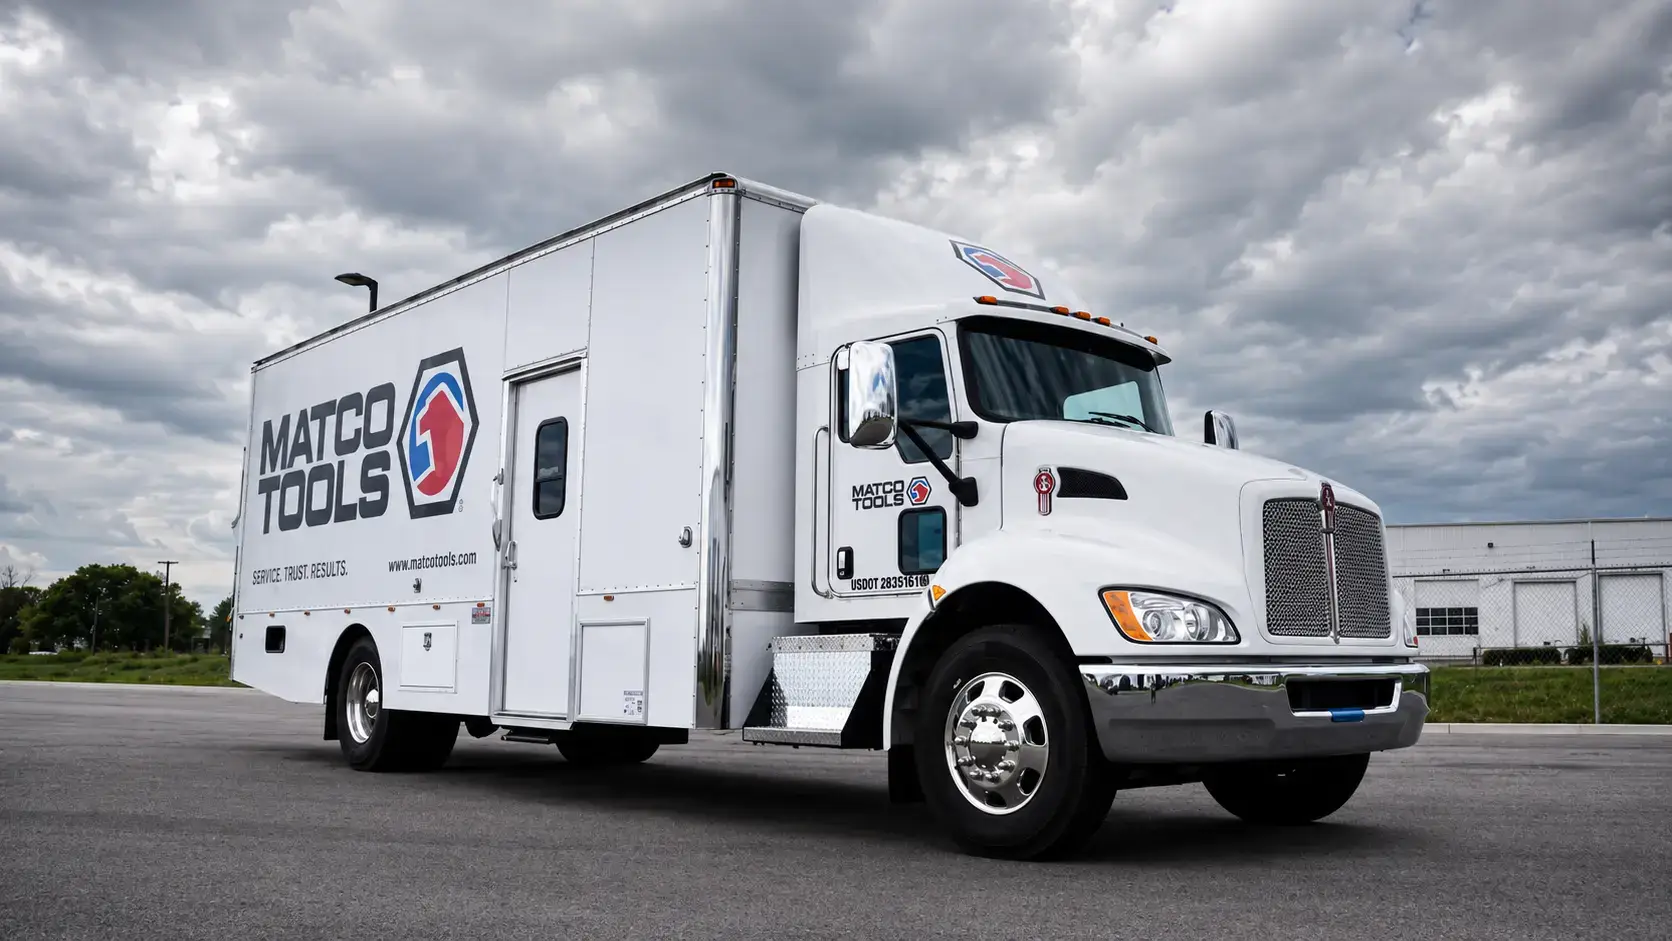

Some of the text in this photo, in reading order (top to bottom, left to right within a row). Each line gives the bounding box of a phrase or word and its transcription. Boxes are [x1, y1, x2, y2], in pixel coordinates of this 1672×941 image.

[259, 381, 396, 476] MATCO
[257, 449, 391, 535] TOOLS
[851, 480, 905, 498] MATCO
[851, 493, 905, 511] TOOLS
[252, 559, 348, 586] SERVICE. TRUST. RESULTS.
[388, 551, 477, 573] www.matcotools.com
[851, 577, 879, 591] USDOT
